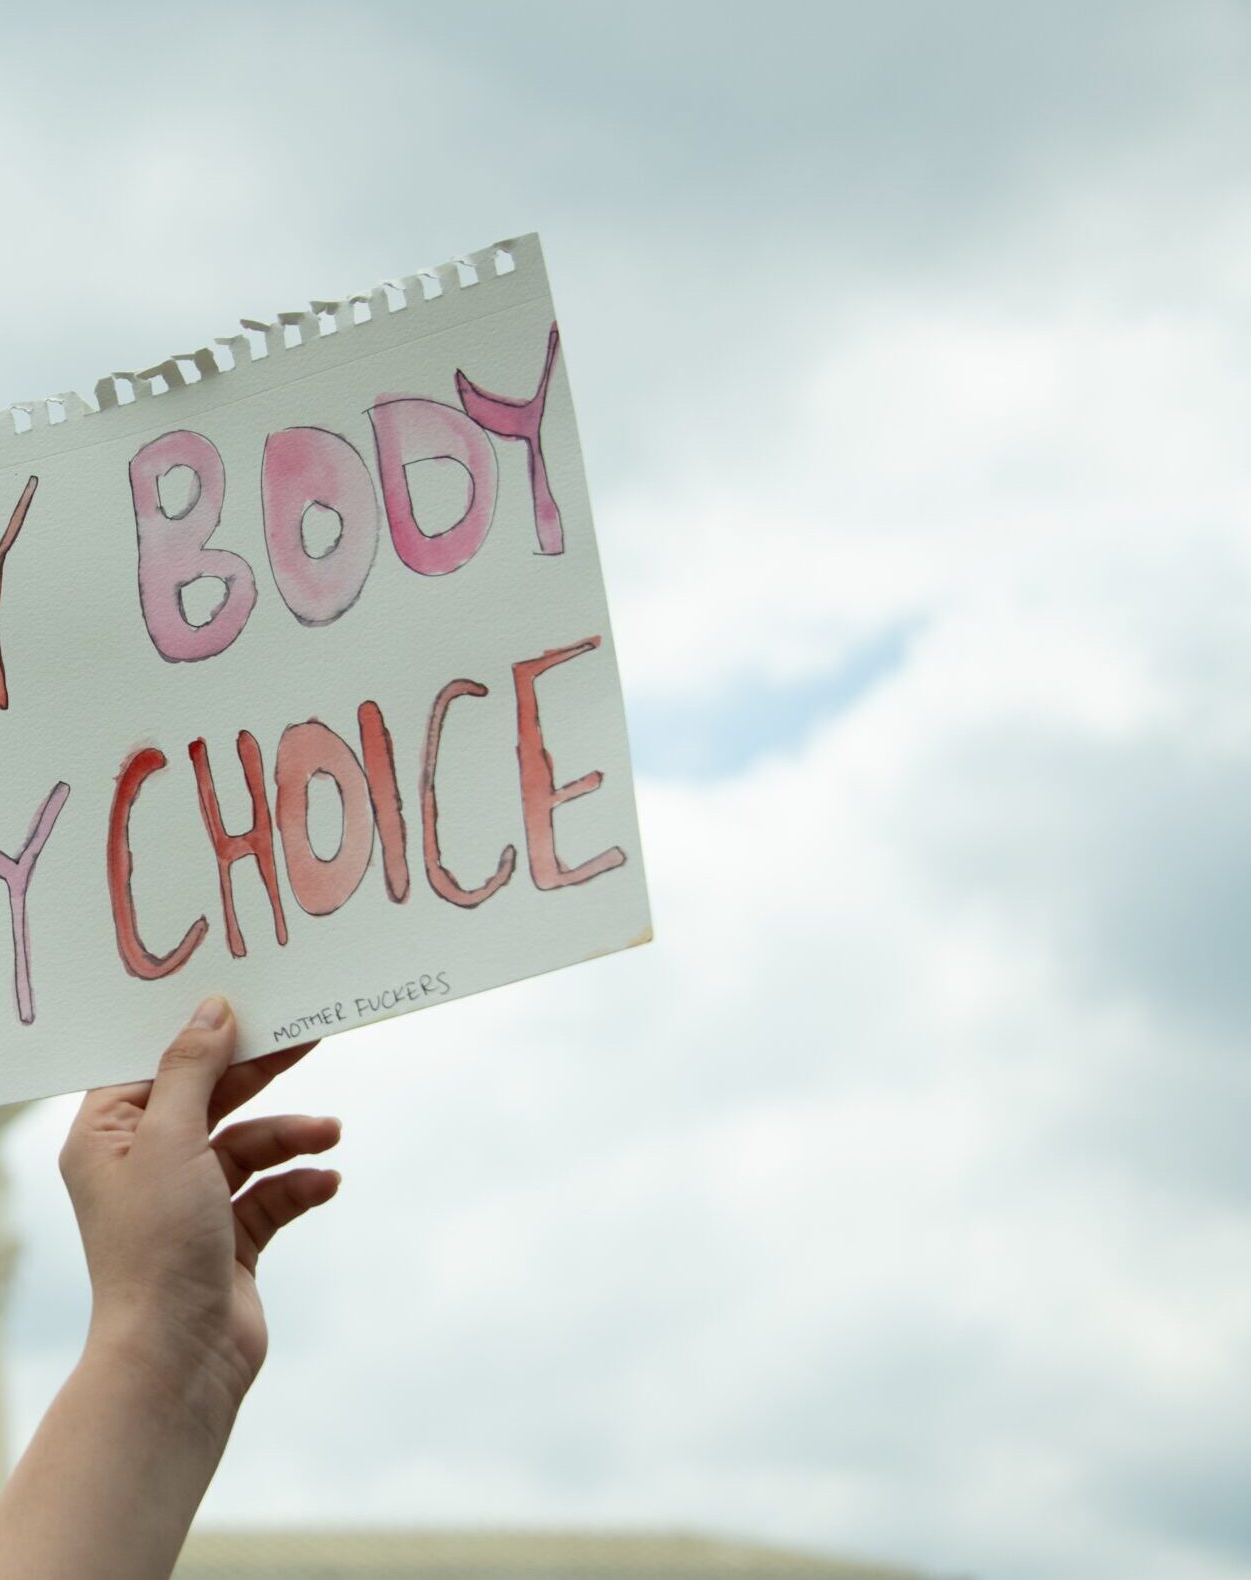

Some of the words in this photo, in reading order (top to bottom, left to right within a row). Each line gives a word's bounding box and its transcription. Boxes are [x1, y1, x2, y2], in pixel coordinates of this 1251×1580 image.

[128, 322, 564, 663] BODY
[107, 634, 626, 980] CHOICE
[273, 1002, 346, 1043] MOTHER
[354, 971, 451, 1017] FUCKERS
